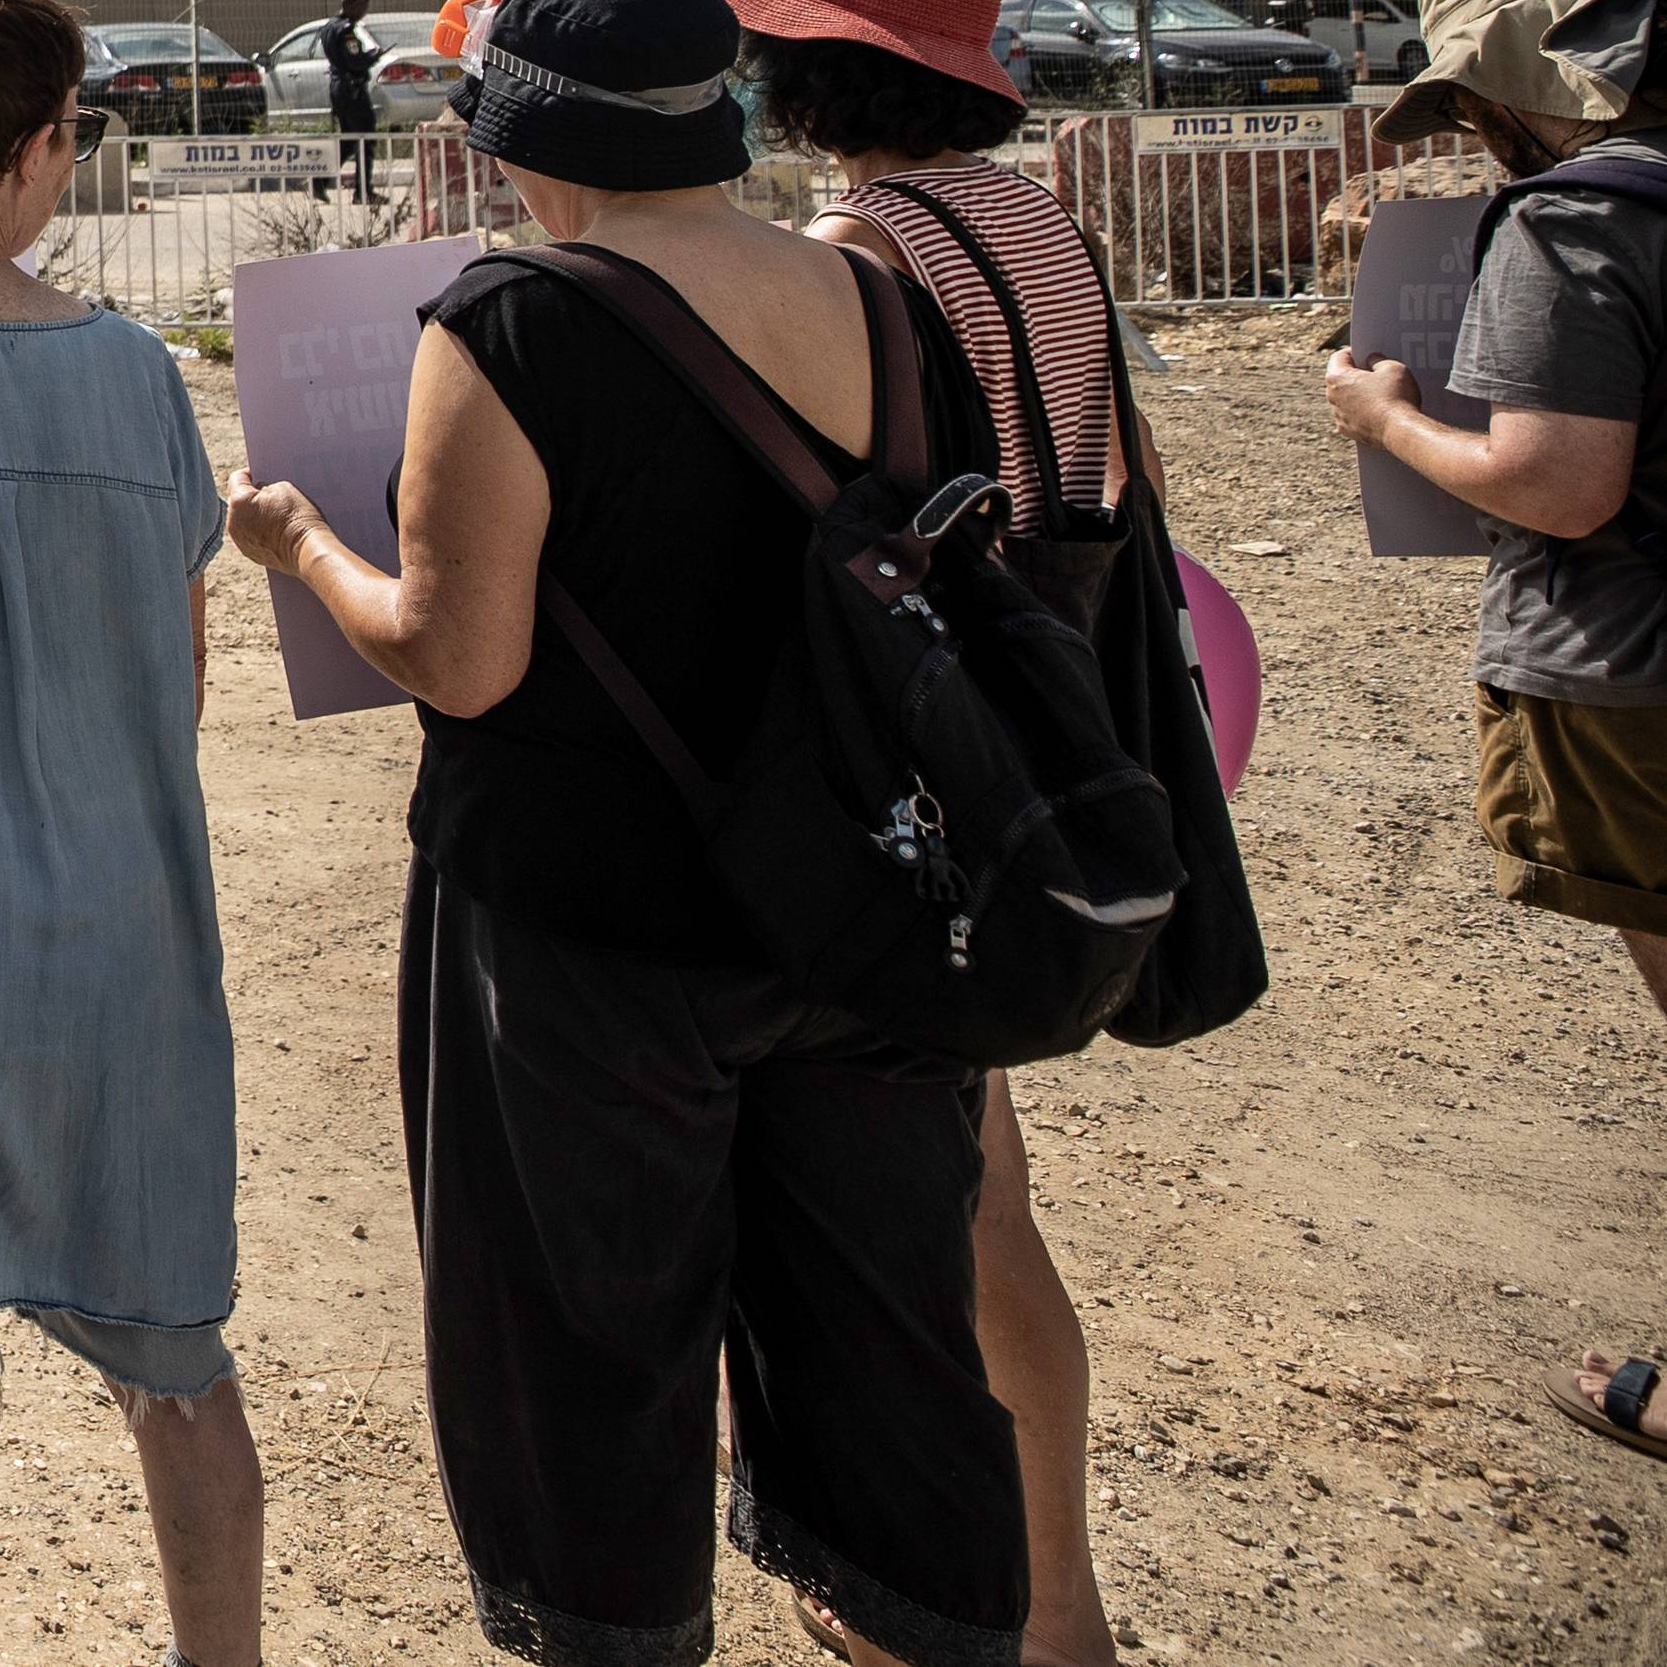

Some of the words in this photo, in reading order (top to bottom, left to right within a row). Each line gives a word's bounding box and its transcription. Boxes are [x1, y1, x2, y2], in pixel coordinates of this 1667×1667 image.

[1173, 116, 1233, 135] במות
[1245, 115, 1299, 135] קשת
[186, 145, 240, 162] במות
[250, 144, 300, 163] קשת
